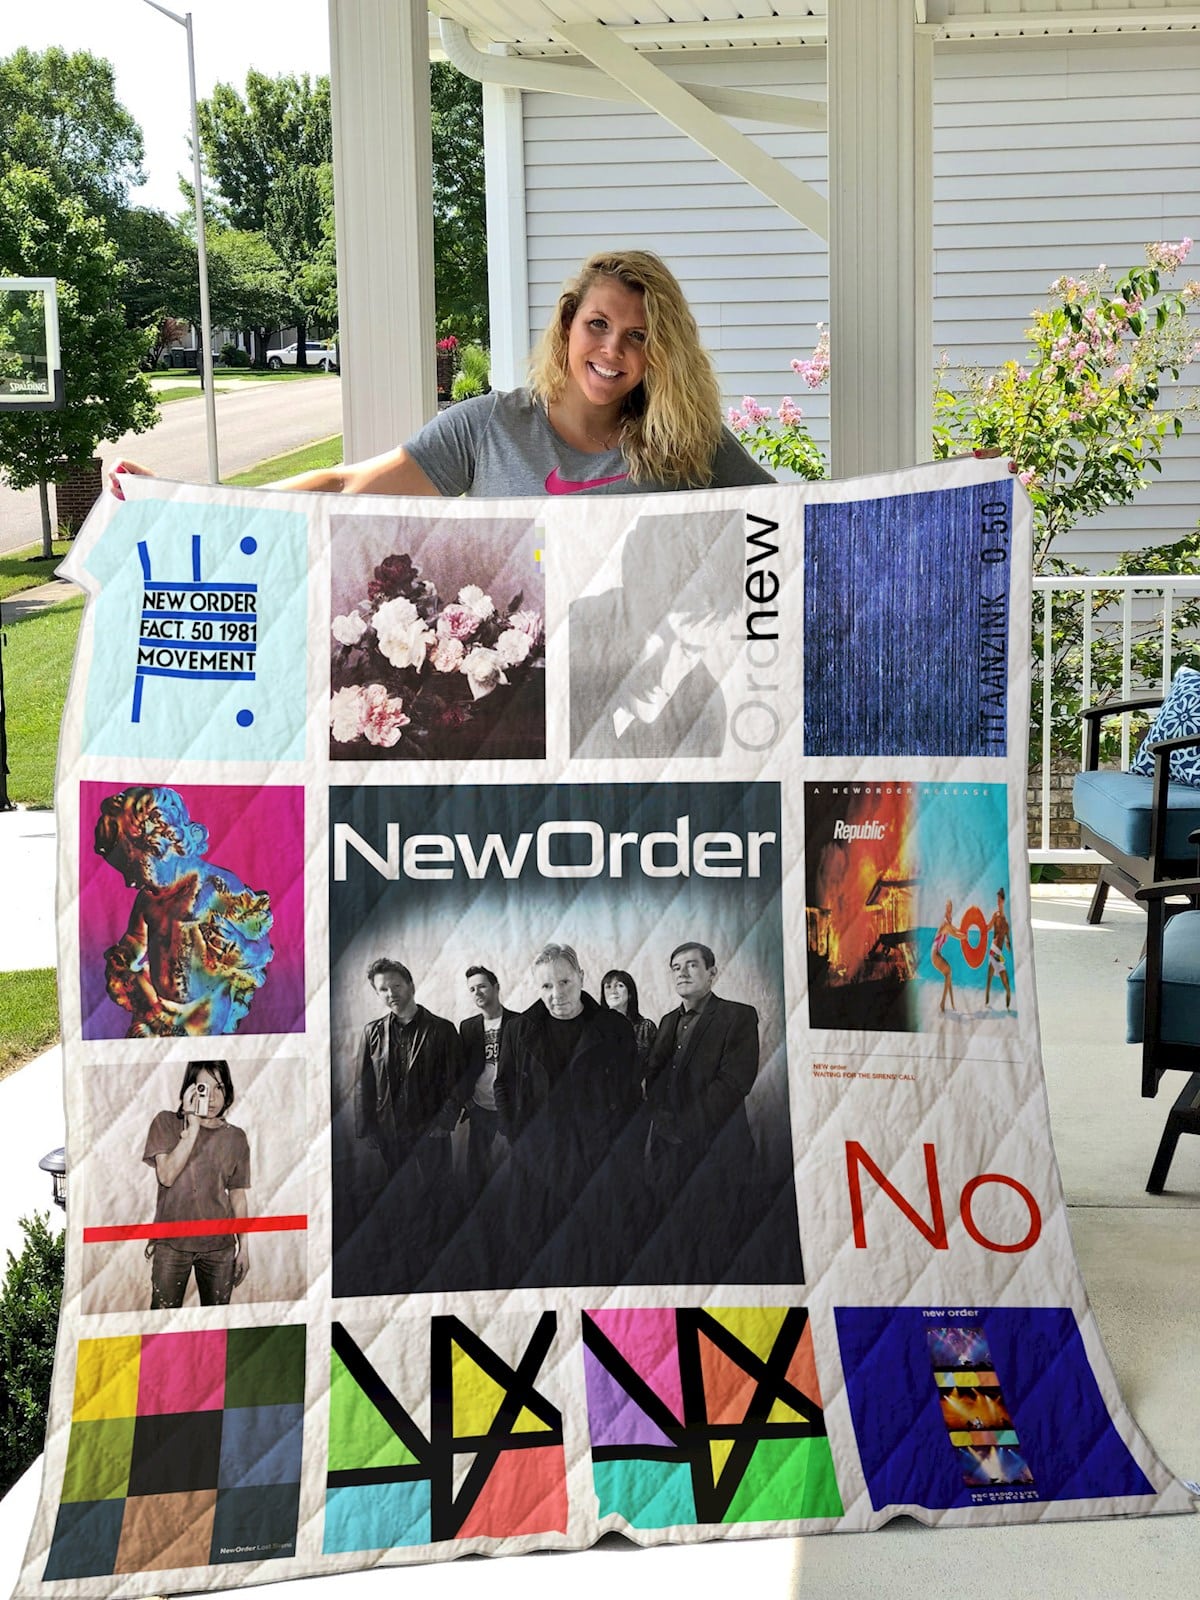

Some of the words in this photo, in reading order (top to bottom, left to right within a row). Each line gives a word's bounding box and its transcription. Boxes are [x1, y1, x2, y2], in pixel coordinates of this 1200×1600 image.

[9, 382, 48, 393] SPALDING
[745, 512, 780, 641] new
[142, 591, 186, 610] NEW
[190, 592, 257, 613] ORDER
[140, 619, 185, 639] FACT.
[191, 621, 213, 640] 50
[219, 623, 257, 642] 1981
[136, 647, 256, 671] MOVEMENT
[833, 819, 886, 842] Republic
[813, 1071, 841, 1079] WAITING
[858, 1072, 870, 1080] THE
[844, 1139, 1042, 1254] No
[922, 1310, 945, 1318] new
[947, 1308, 979, 1318] order
